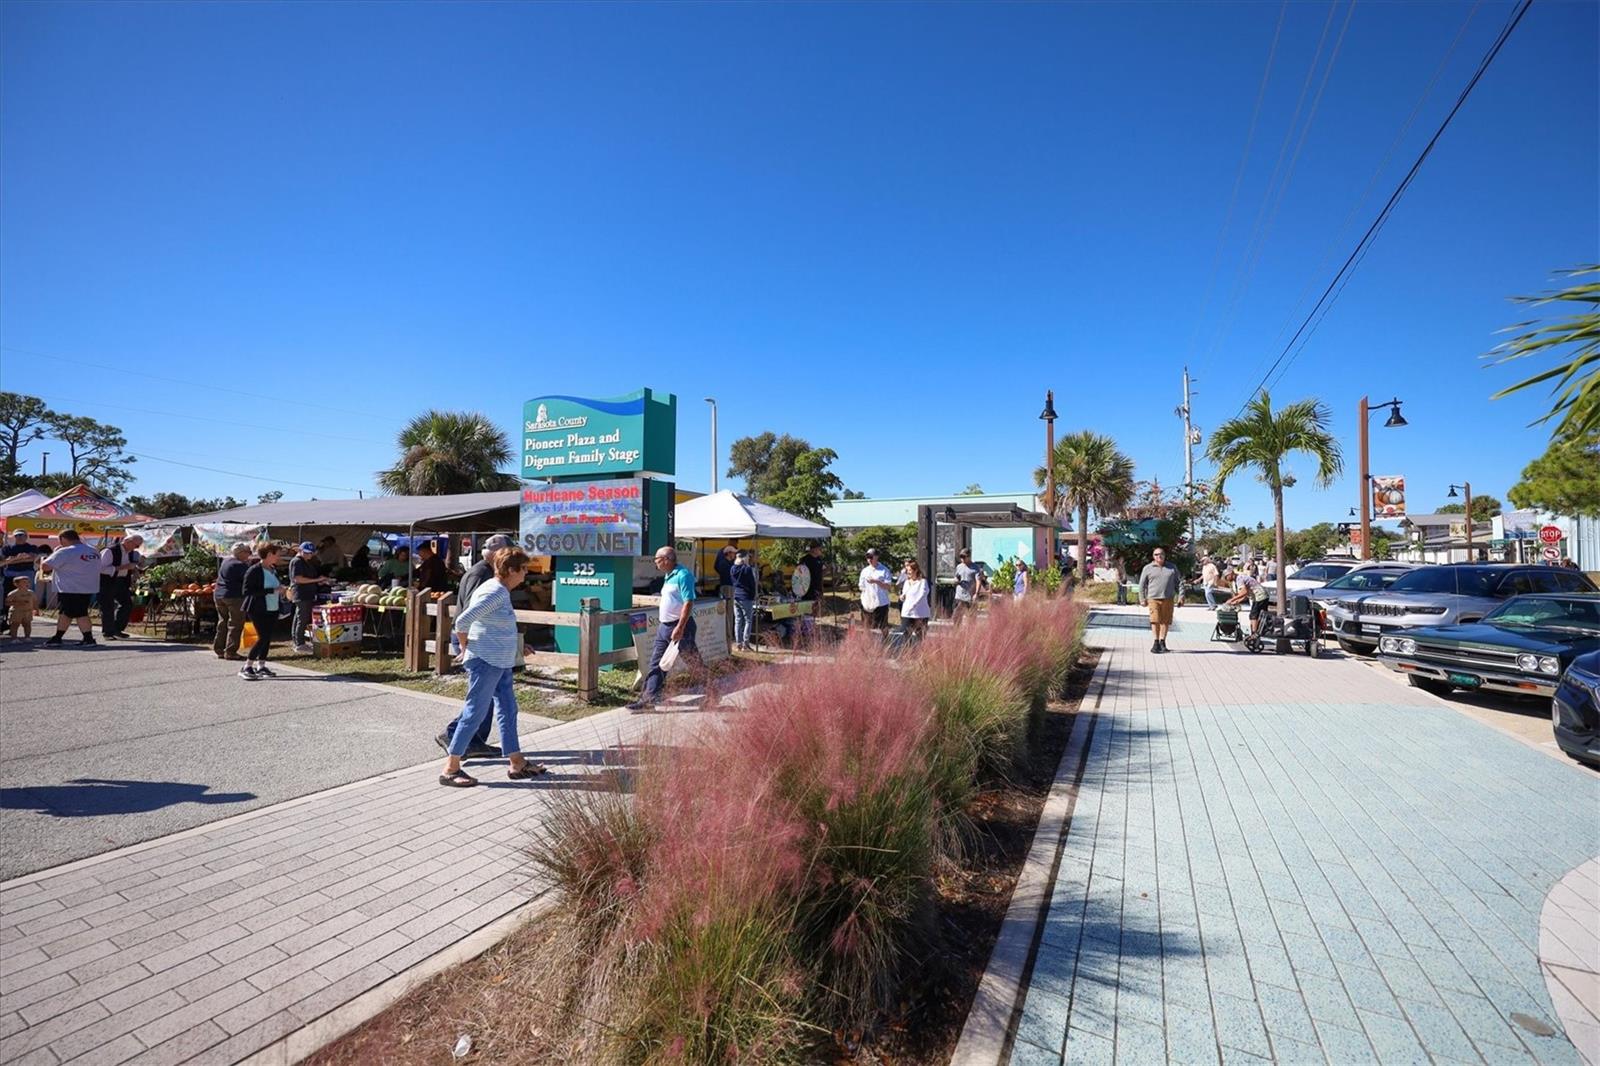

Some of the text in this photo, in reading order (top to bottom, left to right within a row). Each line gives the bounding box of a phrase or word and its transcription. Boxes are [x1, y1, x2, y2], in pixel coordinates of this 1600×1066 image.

[525, 416, 588, 430] Sarasota County
[525, 428, 620, 450] Pioneer Plaza and
[525, 448, 640, 470] Dignam Family Stage
[523, 484, 640, 502] Hurricane Season
[34, 521, 76, 530] COFFEE
[524, 532, 640, 553] SCGOV.NET
[1540, 530, 1561, 539] STOP
[573, 563, 595, 576] 325
